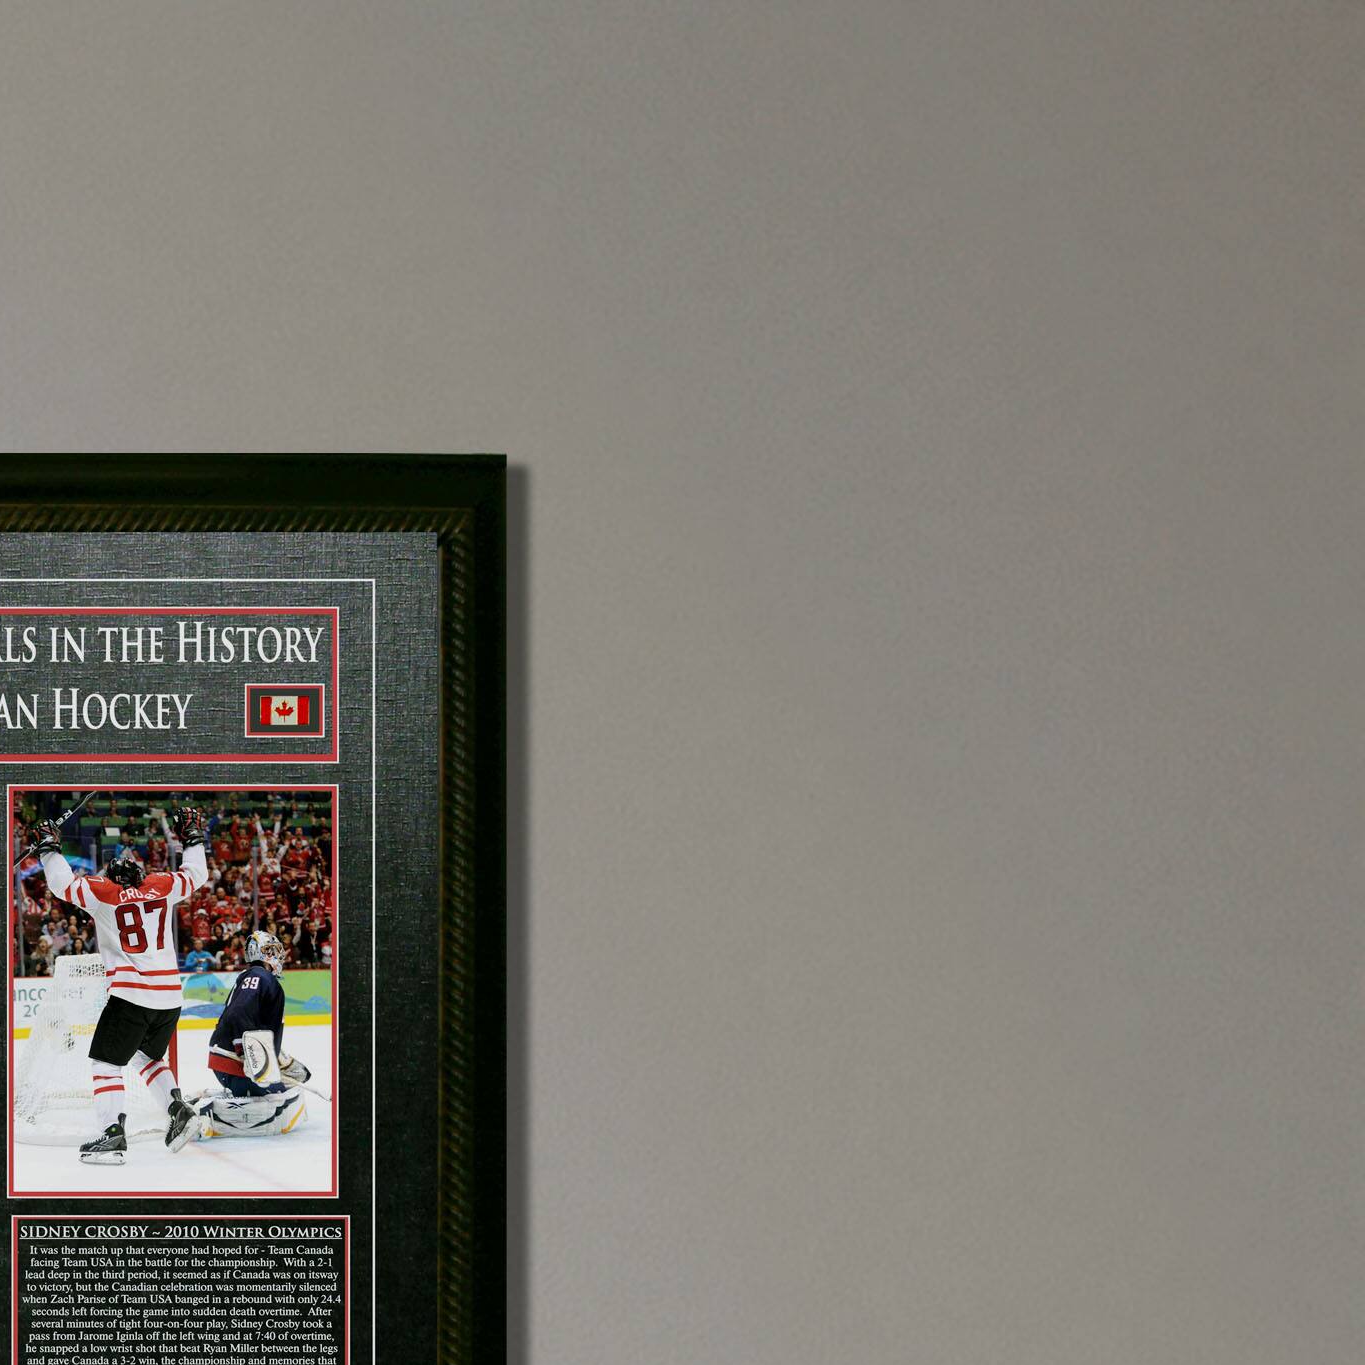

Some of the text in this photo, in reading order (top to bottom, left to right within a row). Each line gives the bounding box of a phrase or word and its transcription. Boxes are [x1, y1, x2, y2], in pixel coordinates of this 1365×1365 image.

[115, 898, 168, 954] 87
[241, 976, 260, 990] 39
[20, 1226, 81, 1237] SIDNEY
[85, 1225, 149, 1237] CROSBY
[165, 1226, 199, 1237] 2010
[30, 1245, 38, 1254] It
[61, 1245, 76, 1254] the
[79, 1245, 108, 1254] match
[111, 1248, 123, 1257] up
[126, 1245, 145, 1254] that
[147, 1248, 189, 1257] everyone
[191, 1245, 209, 1254] had
[212, 1245, 242, 1257] hoped
[245, 1245, 259, 1254] for
[267, 1245, 294, 1254] Team
[296, 1245, 333, 1254] Canada
[32, 1307, 332, 1318] seconds left forcing the game into sudden death overtime. After
[31, 1319, 63, 1328] several
[67, 1319, 104, 1328] minutes
[107, 1319, 117, 1328] of
[119, 1319, 141, 1330] tight
[144, 1319, 204, 1328] four-on-four
[207, 1319, 228, 1330] play,
[231, 1319, 263, 1330] Sidney
[266, 1319, 300, 1330] Crosby
[303, 1319, 324, 1328] took
[27, 1356, 45, 1365] and
[72, 1356, 109, 1365] Canada
[121, 1356, 136, 1365] 3-2
[161, 1356, 176, 1365] the
[248, 1356, 266, 1365] and
[269, 1356, 315, 1365] memories
[318, 1356, 336, 1365] that
